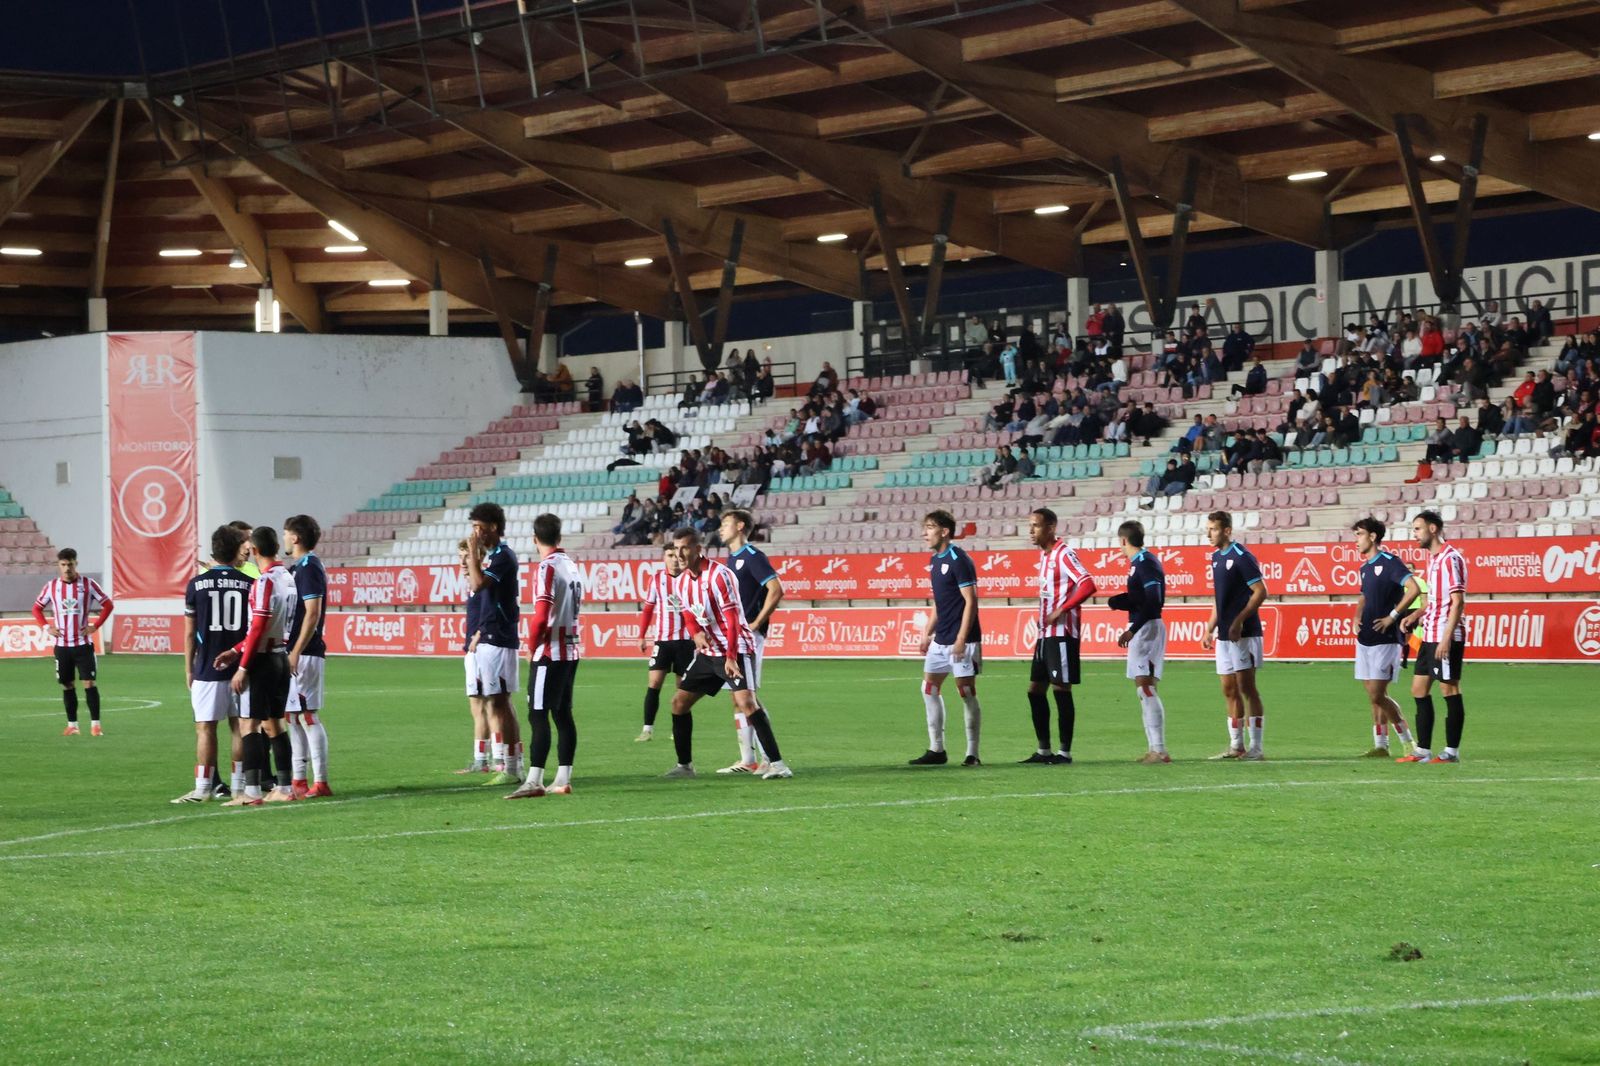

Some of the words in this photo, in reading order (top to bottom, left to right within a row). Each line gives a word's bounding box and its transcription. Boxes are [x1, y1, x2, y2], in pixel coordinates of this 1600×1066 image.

[1128, 287, 1317, 352] STADIO
[141, 482, 167, 521] 8
[1331, 544, 1368, 563] Clínic
[1475, 552, 1542, 567] CARPINTERÍA
[1543, 541, 1600, 584] Ort
[1165, 571, 1193, 586] egorio
[1496, 566, 1526, 578] HIJOS
[1527, 566, 1542, 577] DE
[217, 578, 250, 590] SANCHE
[429, 566, 468, 602] ZAM
[577, 562, 637, 601] MORA
[814, 577, 858, 593] sangregorio
[867, 575, 912, 591] sangregorio
[976, 574, 1020, 590] angregorio
[1286, 583, 1298, 592] El
[1298, 578, 1326, 592] Viso
[208, 590, 243, 632] 10
[355, 615, 405, 642] Freigel
[132, 635, 172, 652] ZAMORA
